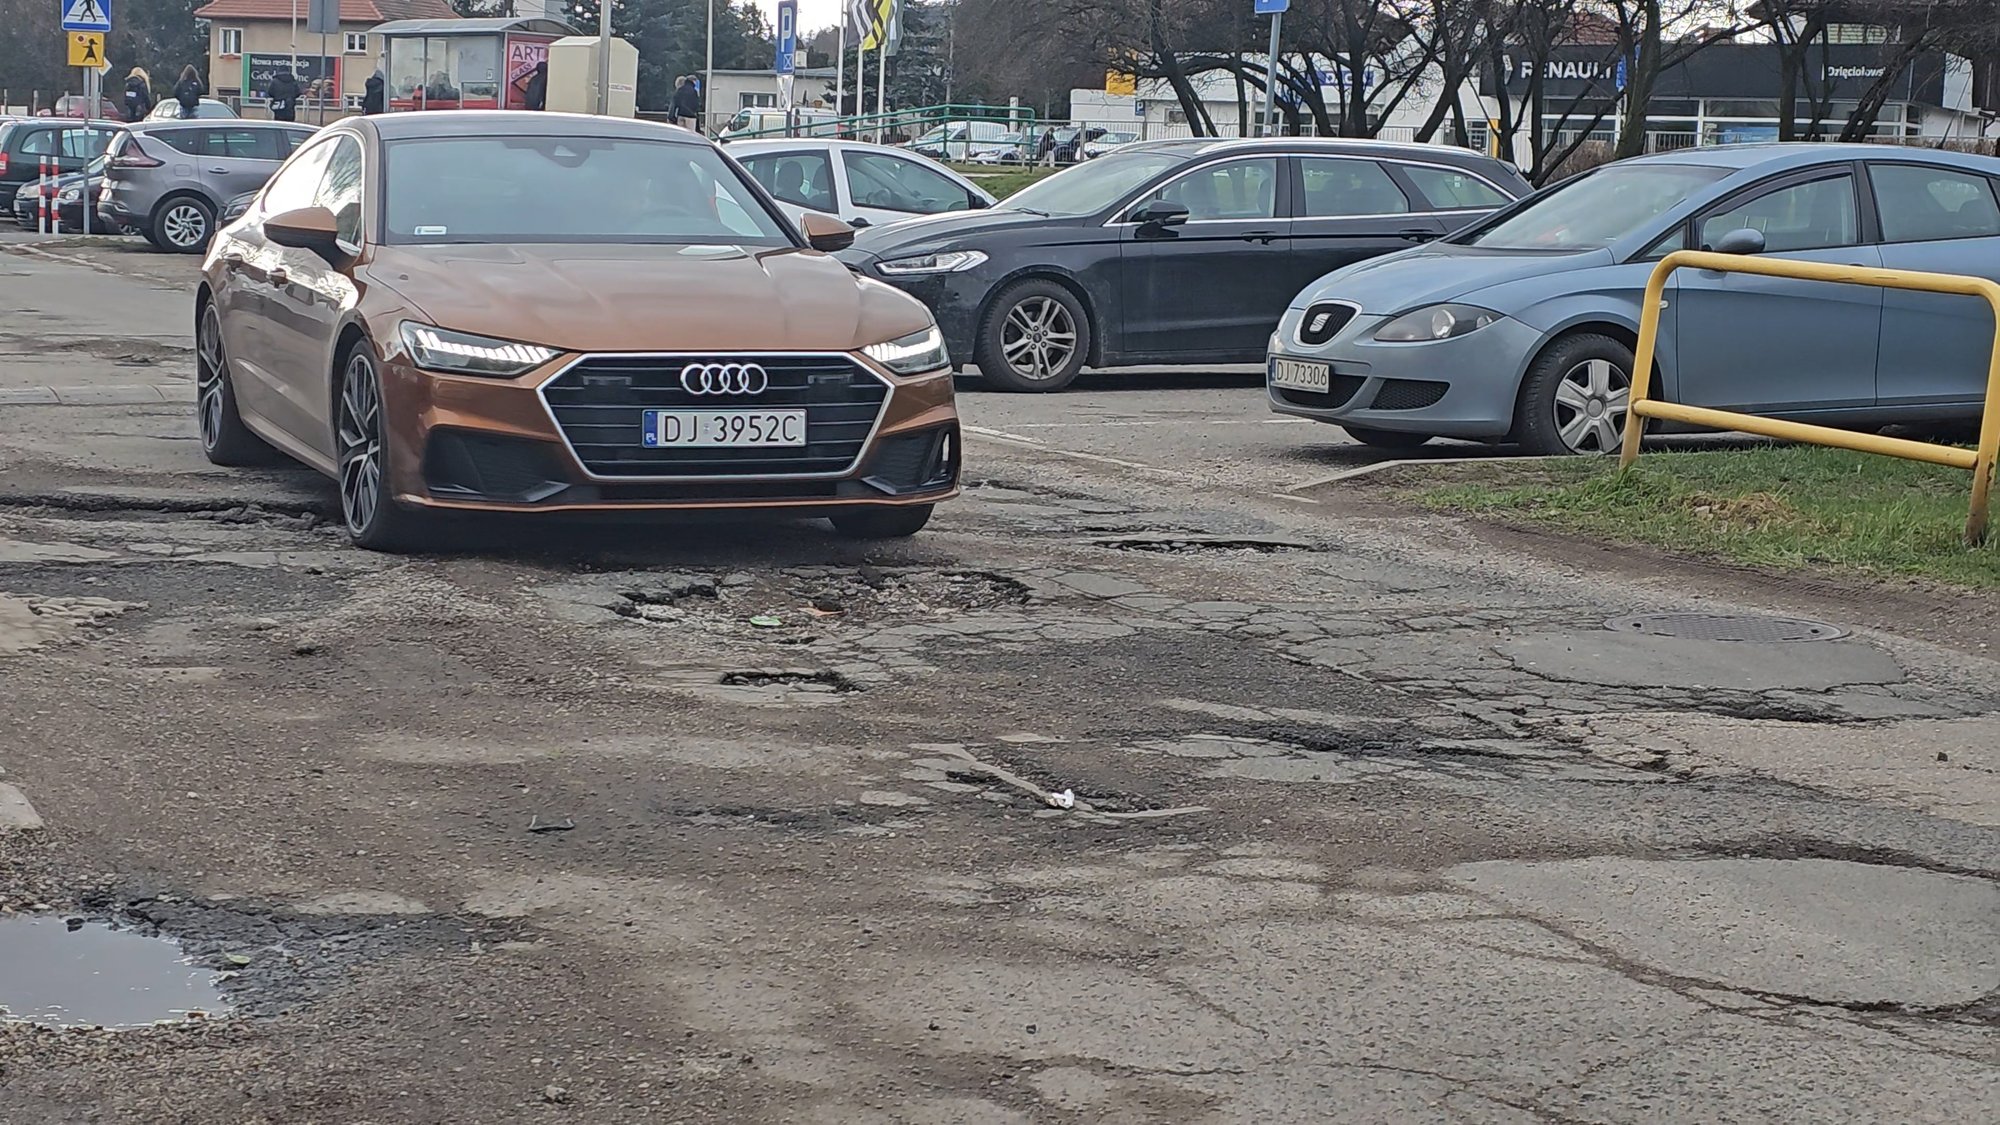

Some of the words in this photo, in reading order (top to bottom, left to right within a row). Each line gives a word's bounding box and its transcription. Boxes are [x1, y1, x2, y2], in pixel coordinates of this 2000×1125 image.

[512, 45, 544, 61] ART
[251, 57, 271, 66] Nowa
[272, 59, 310, 69] restauacja
[1521, 61, 1611, 79] RNAUL
[1276, 361, 1290, 382] DJ
[1294, 363, 1327, 386] 73306
[664, 415, 698, 442] DJ
[713, 415, 797, 442] 3952C
